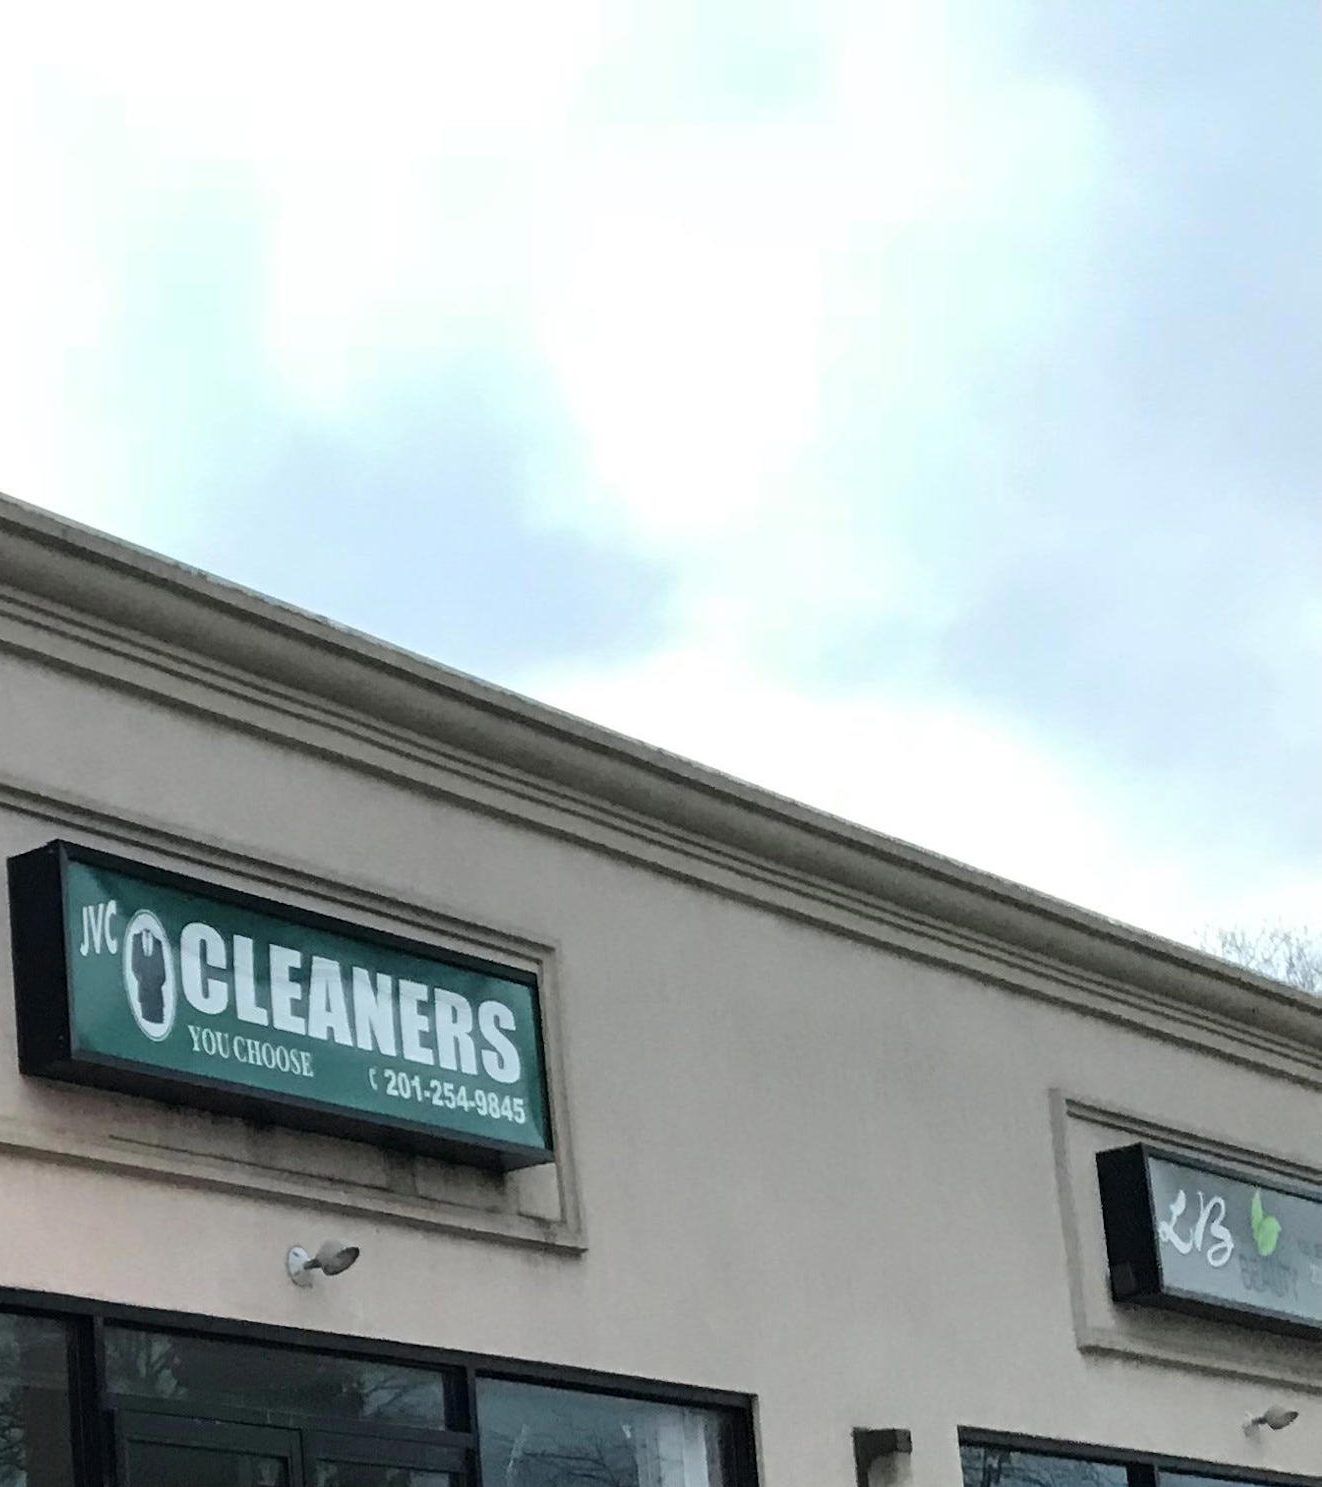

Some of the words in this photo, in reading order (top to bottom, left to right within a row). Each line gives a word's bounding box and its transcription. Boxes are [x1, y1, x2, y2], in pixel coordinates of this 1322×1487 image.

[80, 900, 118, 957] JVC
[180, 922, 522, 1084] CLEANERS
[188, 1025, 230, 1061] YOU
[233, 1038, 315, 1078] CHOOSE
[384, 1069, 526, 1125] 201-254-9845
